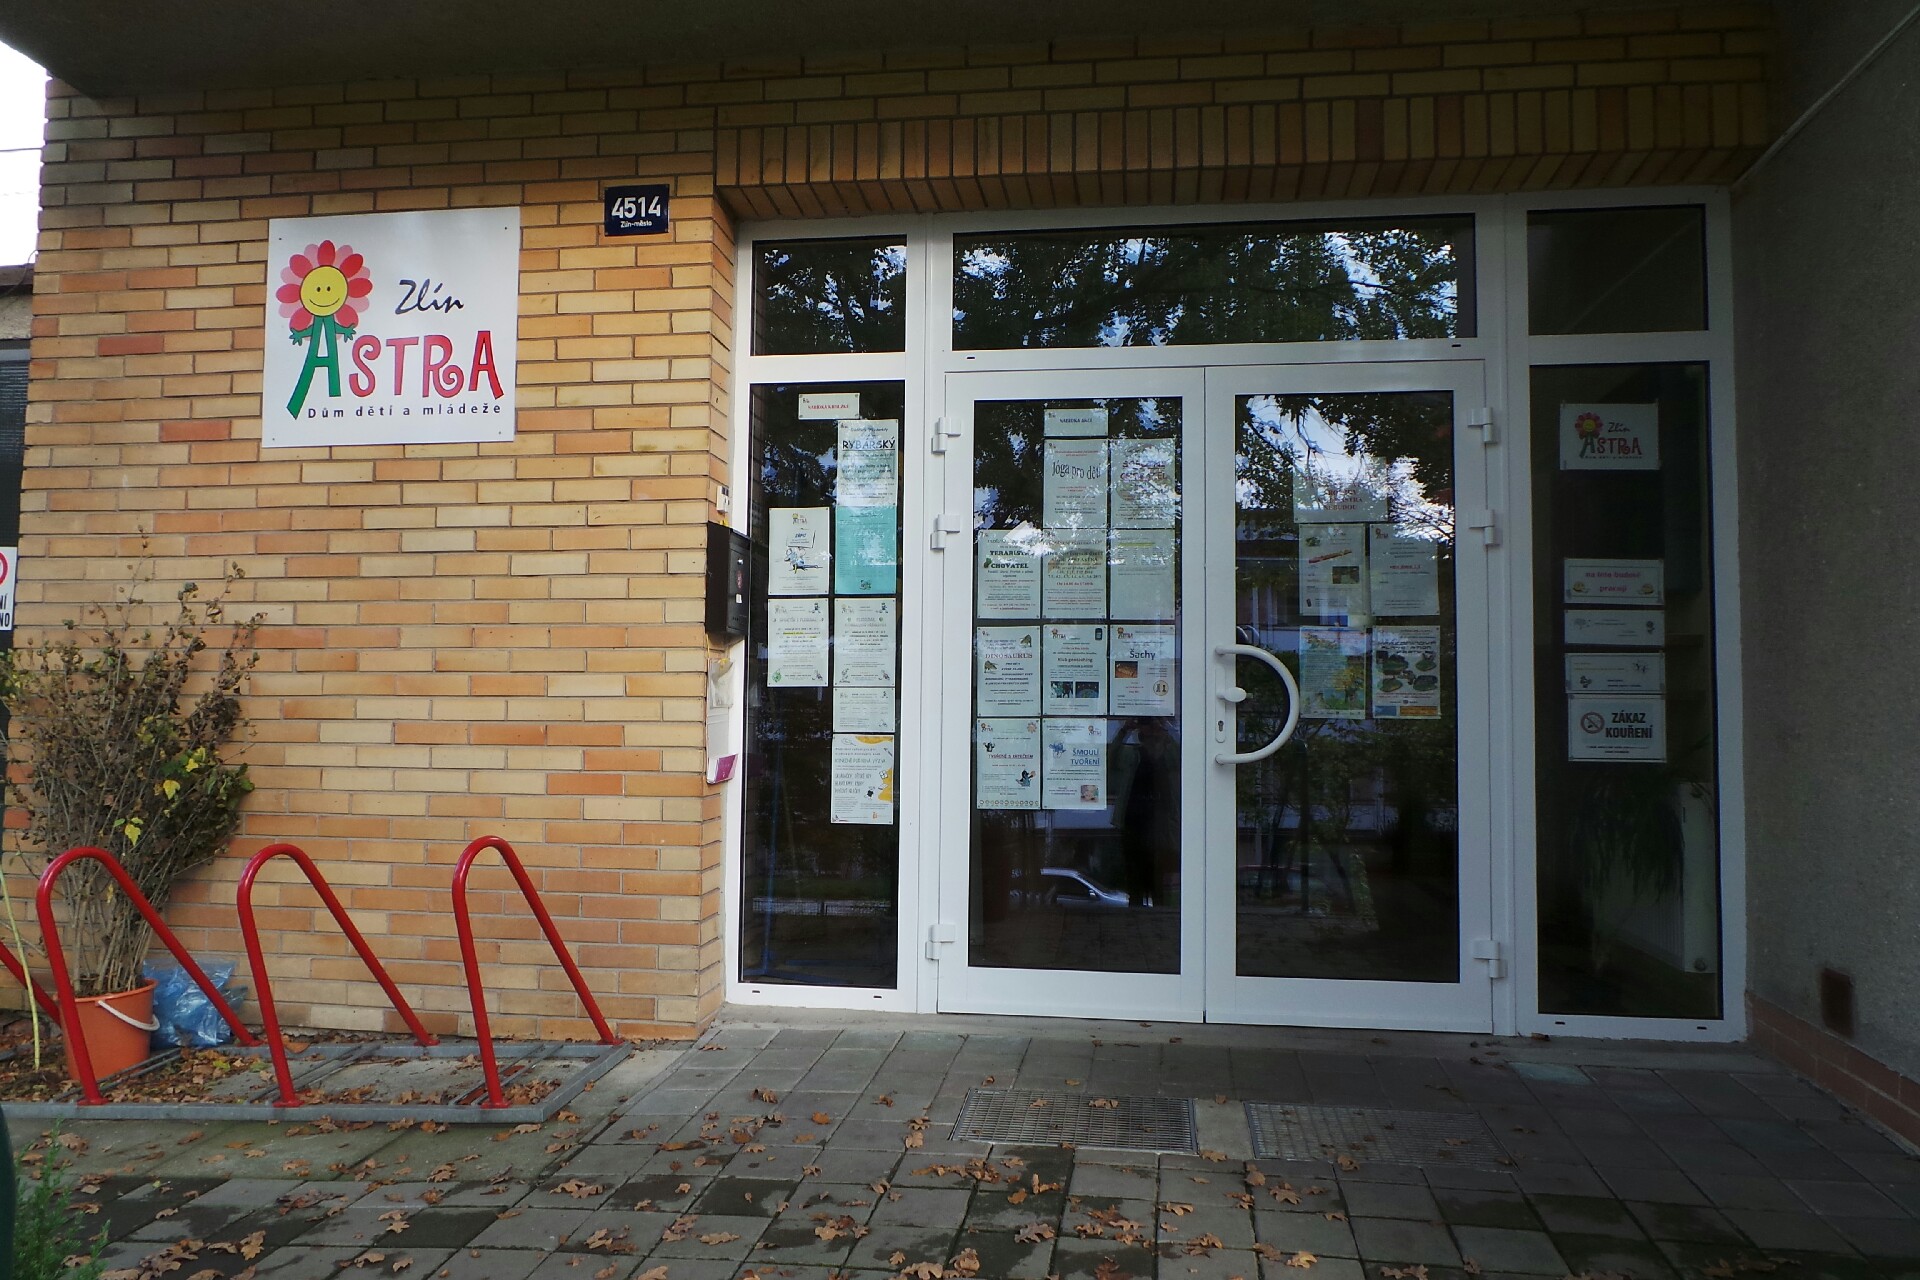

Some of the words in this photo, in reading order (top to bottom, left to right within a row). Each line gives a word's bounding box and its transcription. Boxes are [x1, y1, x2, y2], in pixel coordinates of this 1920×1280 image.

[611, 195, 661, 219] 4514
[394, 278, 465, 315] Zlín
[286, 317, 505, 420] ASTRA
[307, 406, 345, 419] Dům
[402, 406, 411, 416] a
[422, 402, 502, 416] mládeže
[1579, 432, 1643, 458] ASTRA
[1052, 460, 1070, 478] Jóga
[1072, 466, 1085, 479] pro
[1130, 648, 1156, 660] Šachy
[1611, 709, 1646, 723] ZÁKAZ
[1605, 725, 1653, 738] KOUŘENÍ
